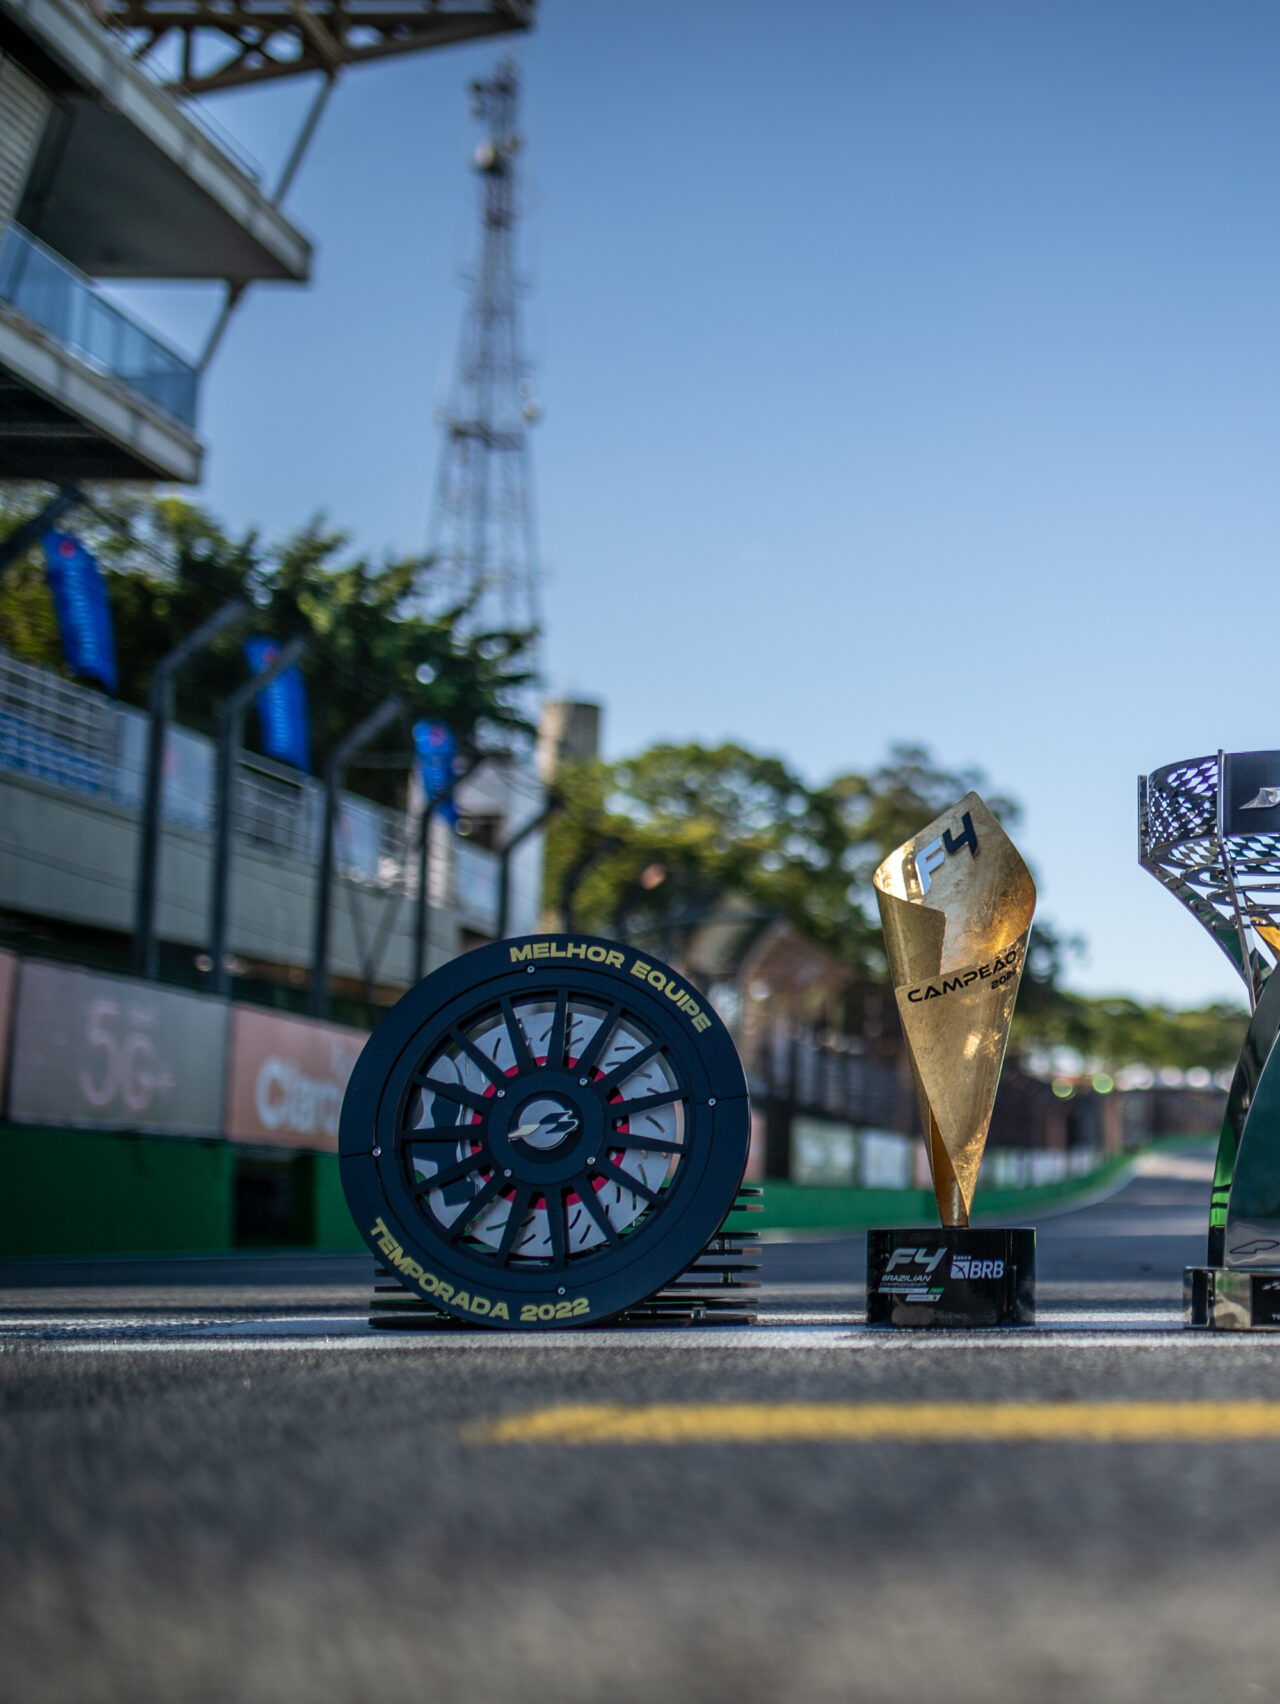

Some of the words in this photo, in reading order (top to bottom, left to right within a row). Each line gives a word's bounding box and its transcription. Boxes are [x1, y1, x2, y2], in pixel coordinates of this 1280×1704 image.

[915, 811, 979, 896] F4
[509, 942, 625, 969] MELHOR
[630, 959, 713, 1034] EQUIPE
[907, 950, 1018, 1004] CAMPEÃO
[369, 1216, 510, 1321] TEMPORADA
[519, 1297, 591, 1322] 2022
[881, 1274, 932, 1282] BRAZILIAN
[885, 1247, 948, 1273] F4
[969, 1259, 1005, 1280] BRB
